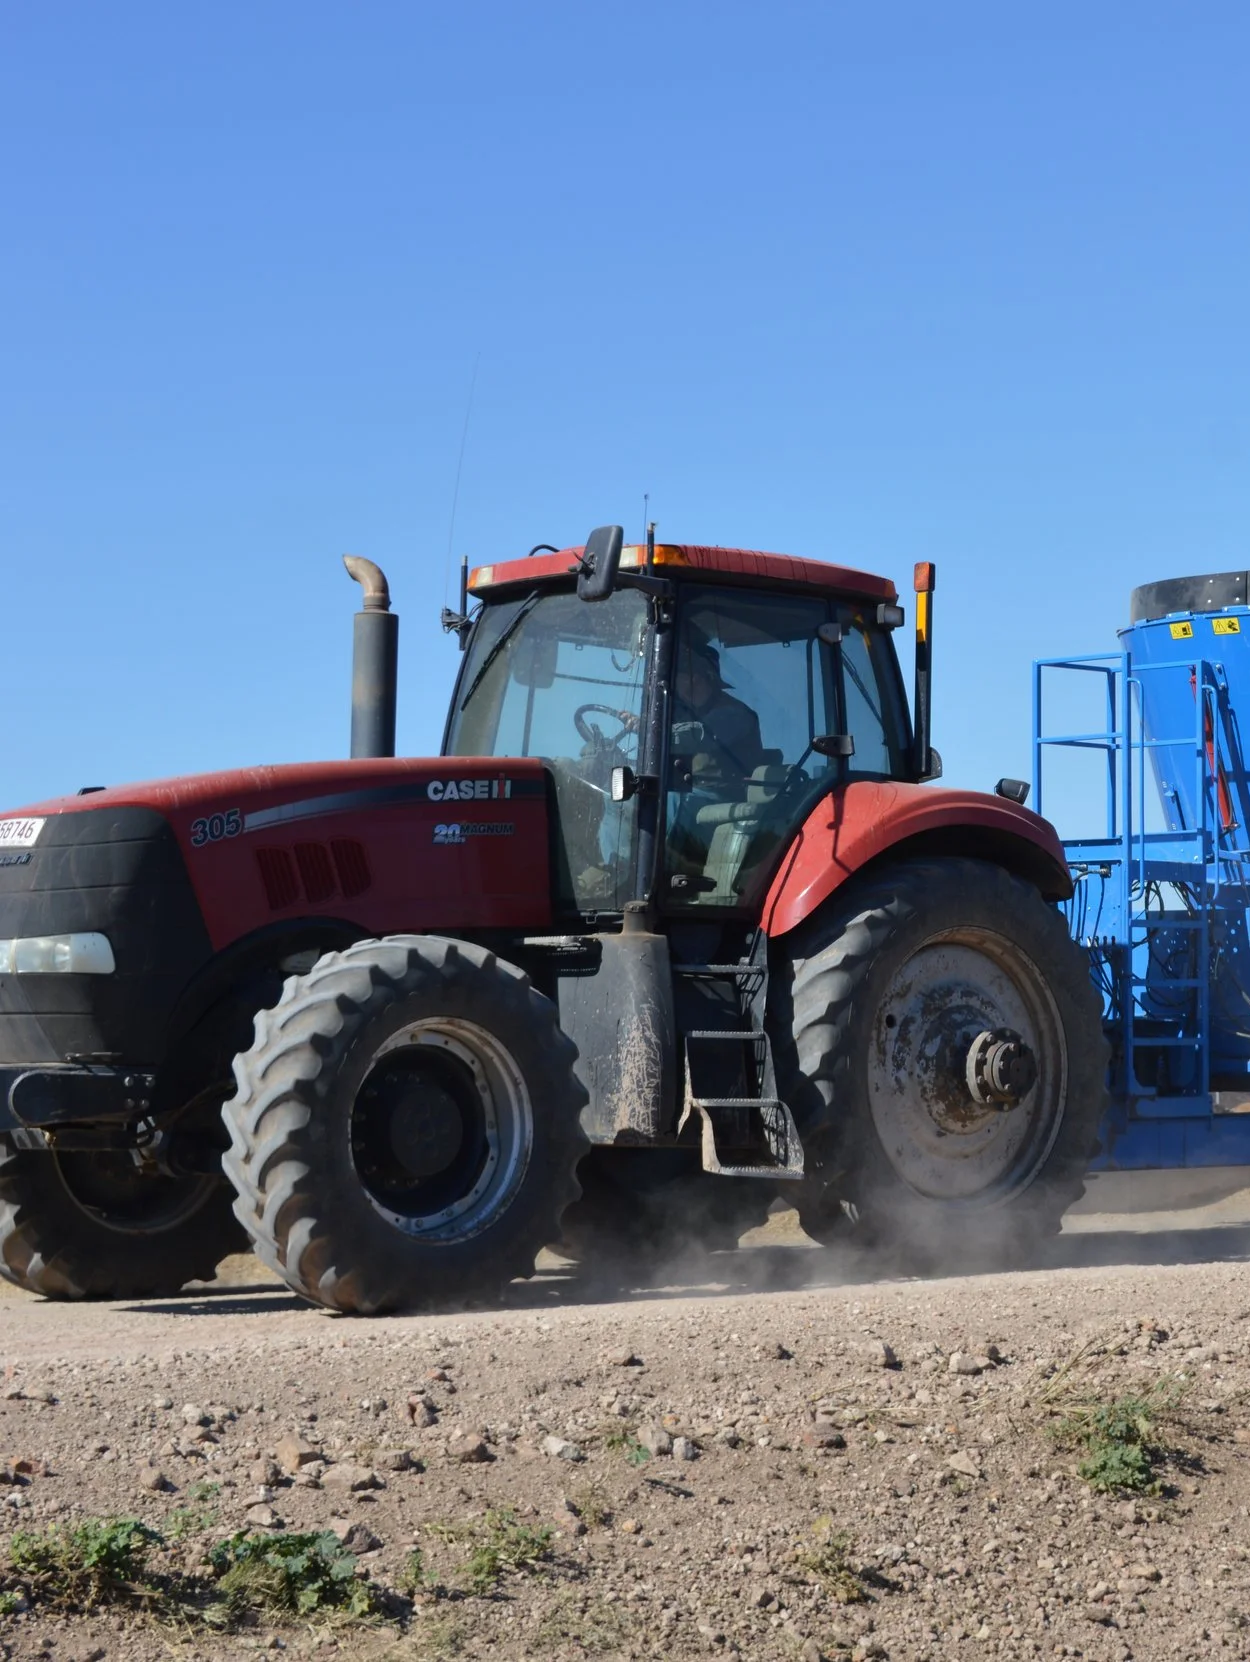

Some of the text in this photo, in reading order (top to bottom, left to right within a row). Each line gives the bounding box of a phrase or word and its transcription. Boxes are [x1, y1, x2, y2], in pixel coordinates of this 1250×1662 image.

[427, 779, 489, 801] CASE
[191, 807, 242, 847] 305
[432, 822, 515, 844] 20 MAGNUM
